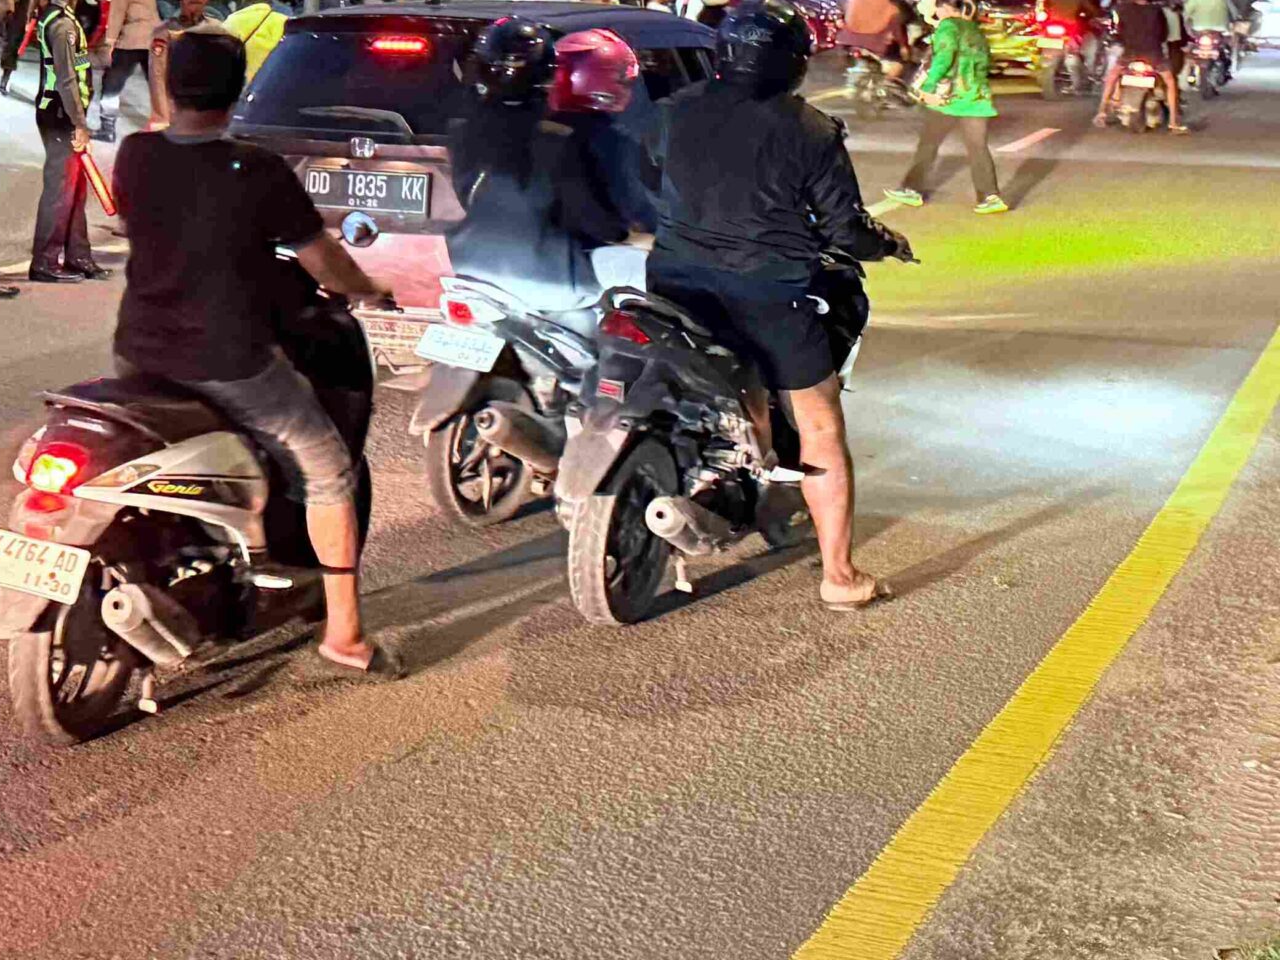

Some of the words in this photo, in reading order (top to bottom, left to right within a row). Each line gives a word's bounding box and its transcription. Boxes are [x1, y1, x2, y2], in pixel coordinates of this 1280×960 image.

[308, 171, 330, 194] DD
[347, 173, 388, 198] 1835
[401, 176, 424, 201] KK
[147, 480, 204, 495] Genio
[3, 538, 50, 565] 4764
[53, 550, 79, 573] AD
